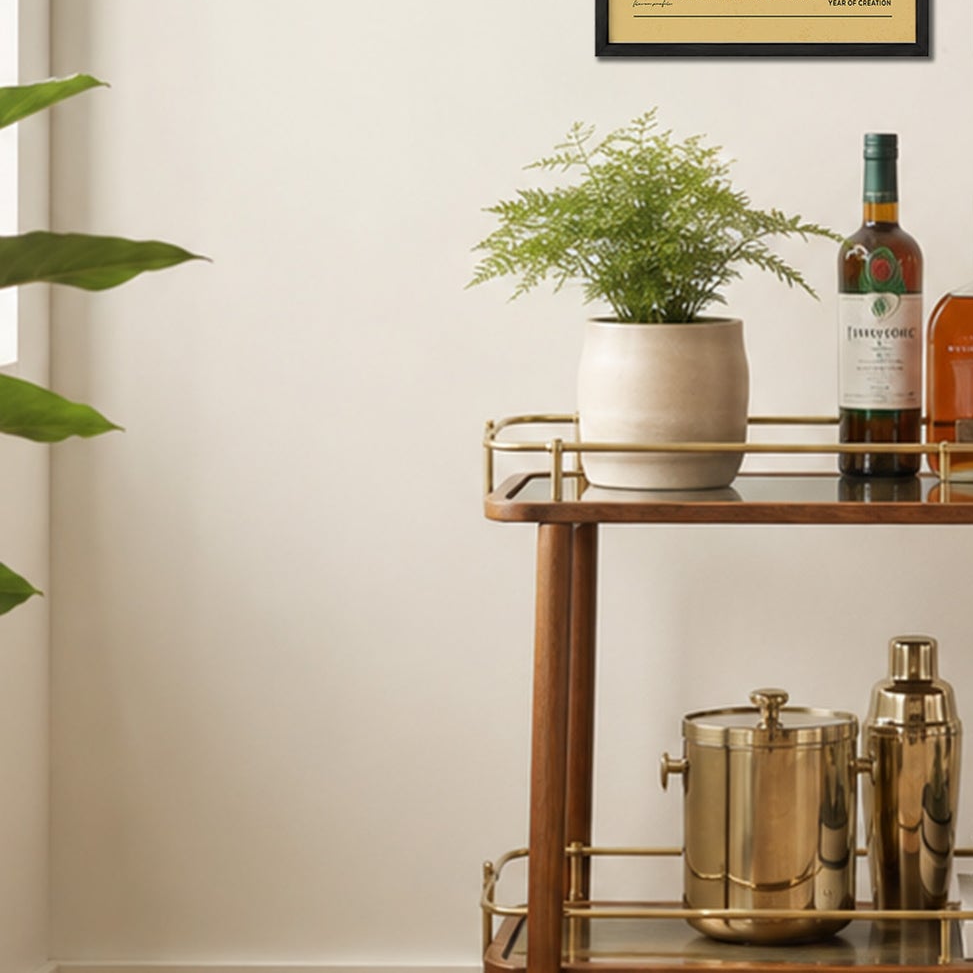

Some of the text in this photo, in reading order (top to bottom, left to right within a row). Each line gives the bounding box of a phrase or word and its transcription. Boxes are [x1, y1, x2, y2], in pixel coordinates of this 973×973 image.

[828, 0, 892, 7] YEAR OF CREATION
